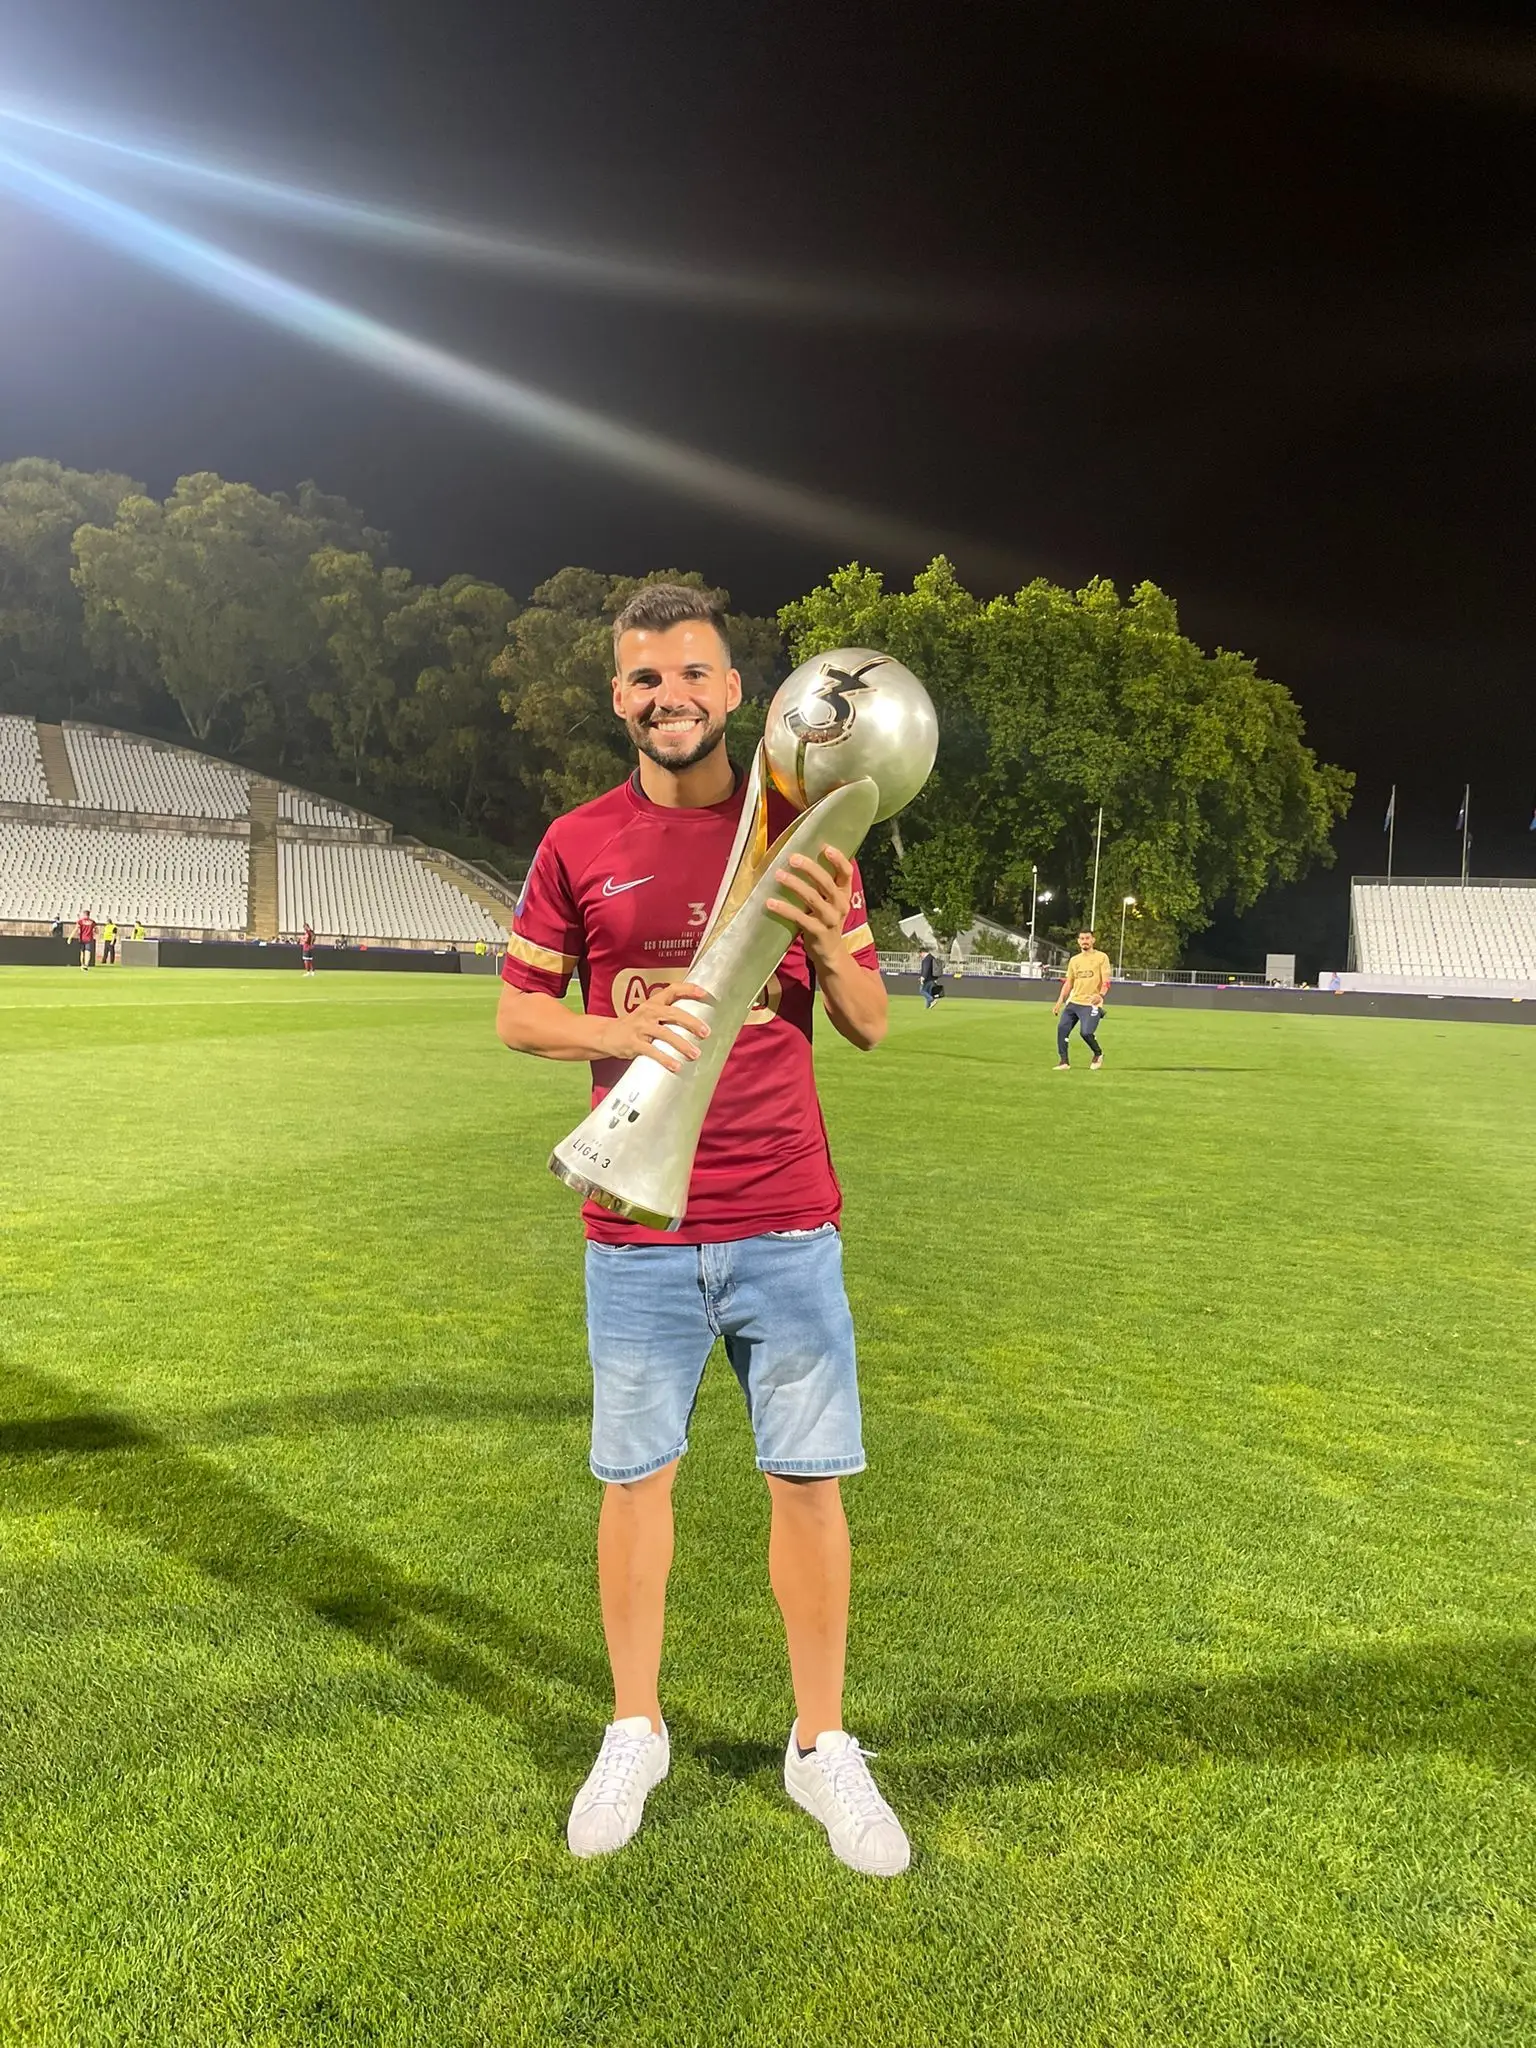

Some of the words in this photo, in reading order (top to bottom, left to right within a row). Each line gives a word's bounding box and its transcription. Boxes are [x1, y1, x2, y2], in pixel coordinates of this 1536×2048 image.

[784, 662, 872, 748] 3
[687, 902, 708, 926] 3
[572, 1138, 599, 1163] LIGA
[601, 1158, 611, 1169] 3
